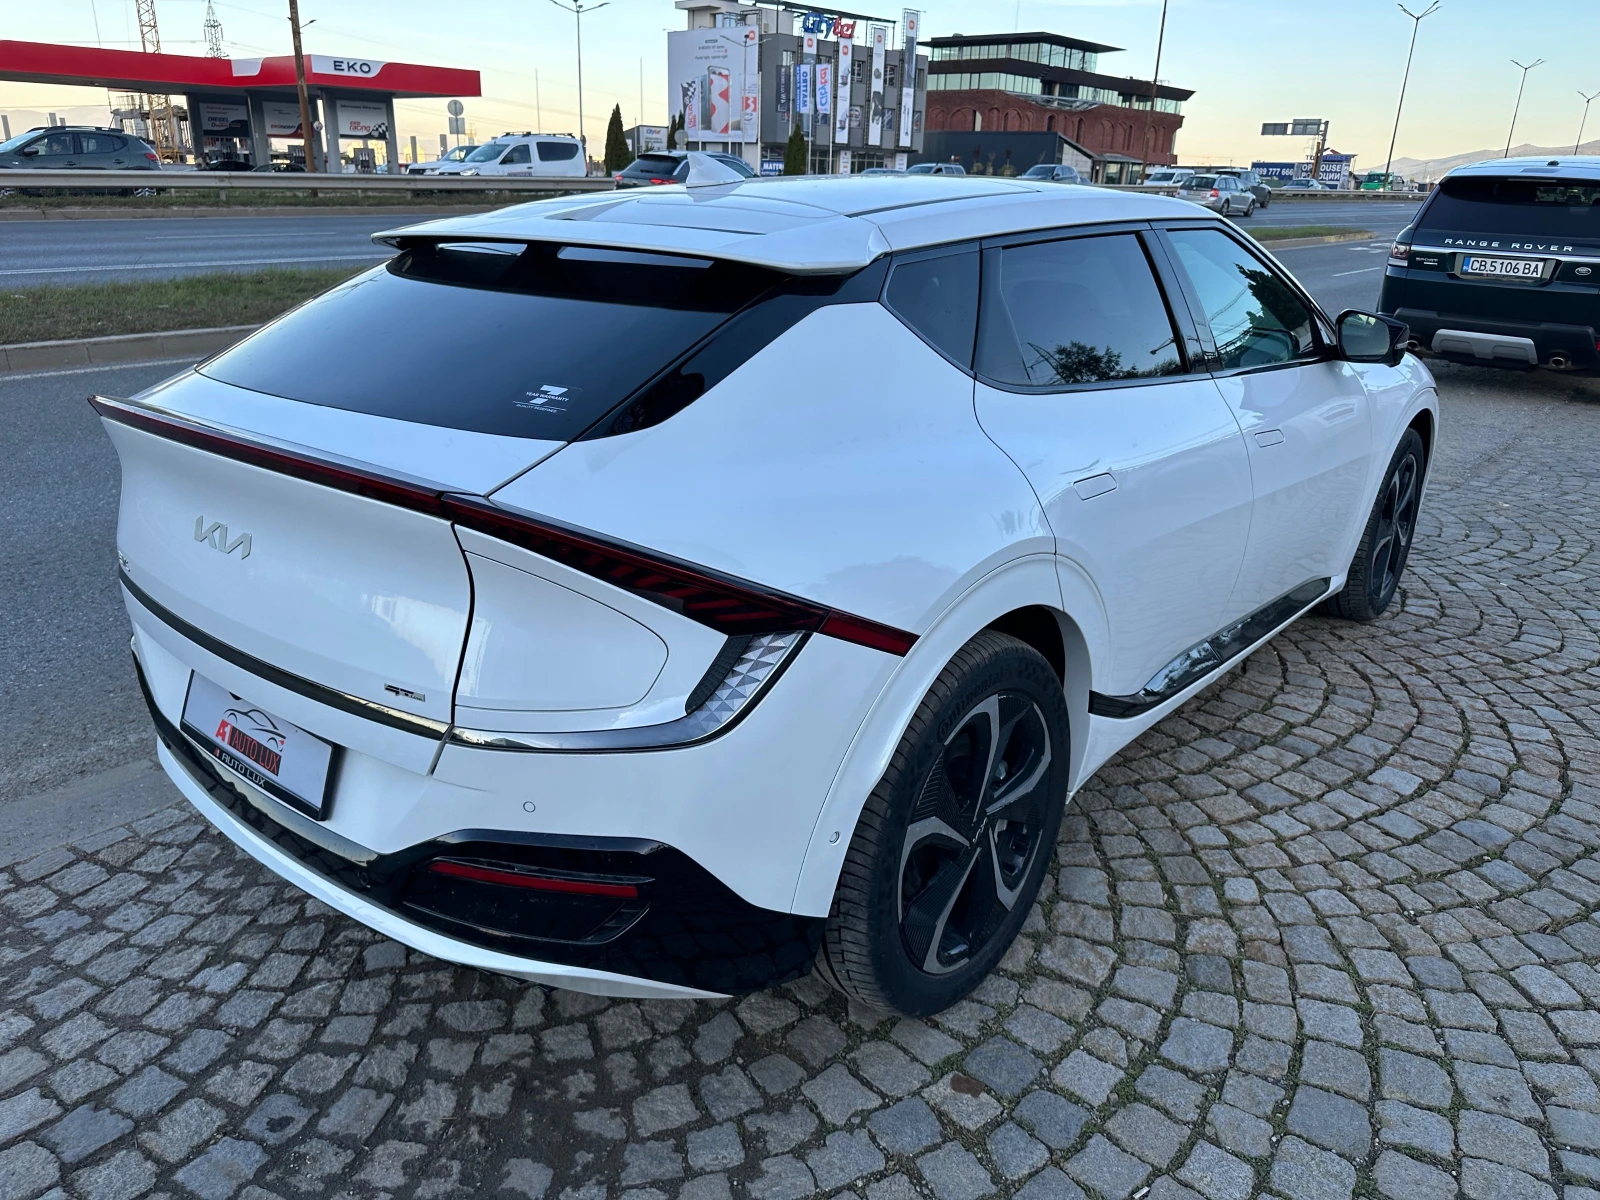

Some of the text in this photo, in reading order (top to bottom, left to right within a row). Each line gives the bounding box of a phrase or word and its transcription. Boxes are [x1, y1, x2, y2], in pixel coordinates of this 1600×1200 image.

[803, 11, 857, 39] Citytel
[333, 60, 371, 74] EKO
[1281, 168, 1294, 176] 666
[1444, 238, 1573, 252] RANGE ROVER
[1522, 263, 1539, 276] BA
[540, 394, 569, 402] WARRANTY
[194, 515, 252, 560] KIA
[937, 666, 1003, 743] Continental
[231, 730, 258, 760] AUTO
[259, 746, 280, 775] LUX
[221, 752, 245, 774] AUTO
[246, 769, 266, 788] LUX
